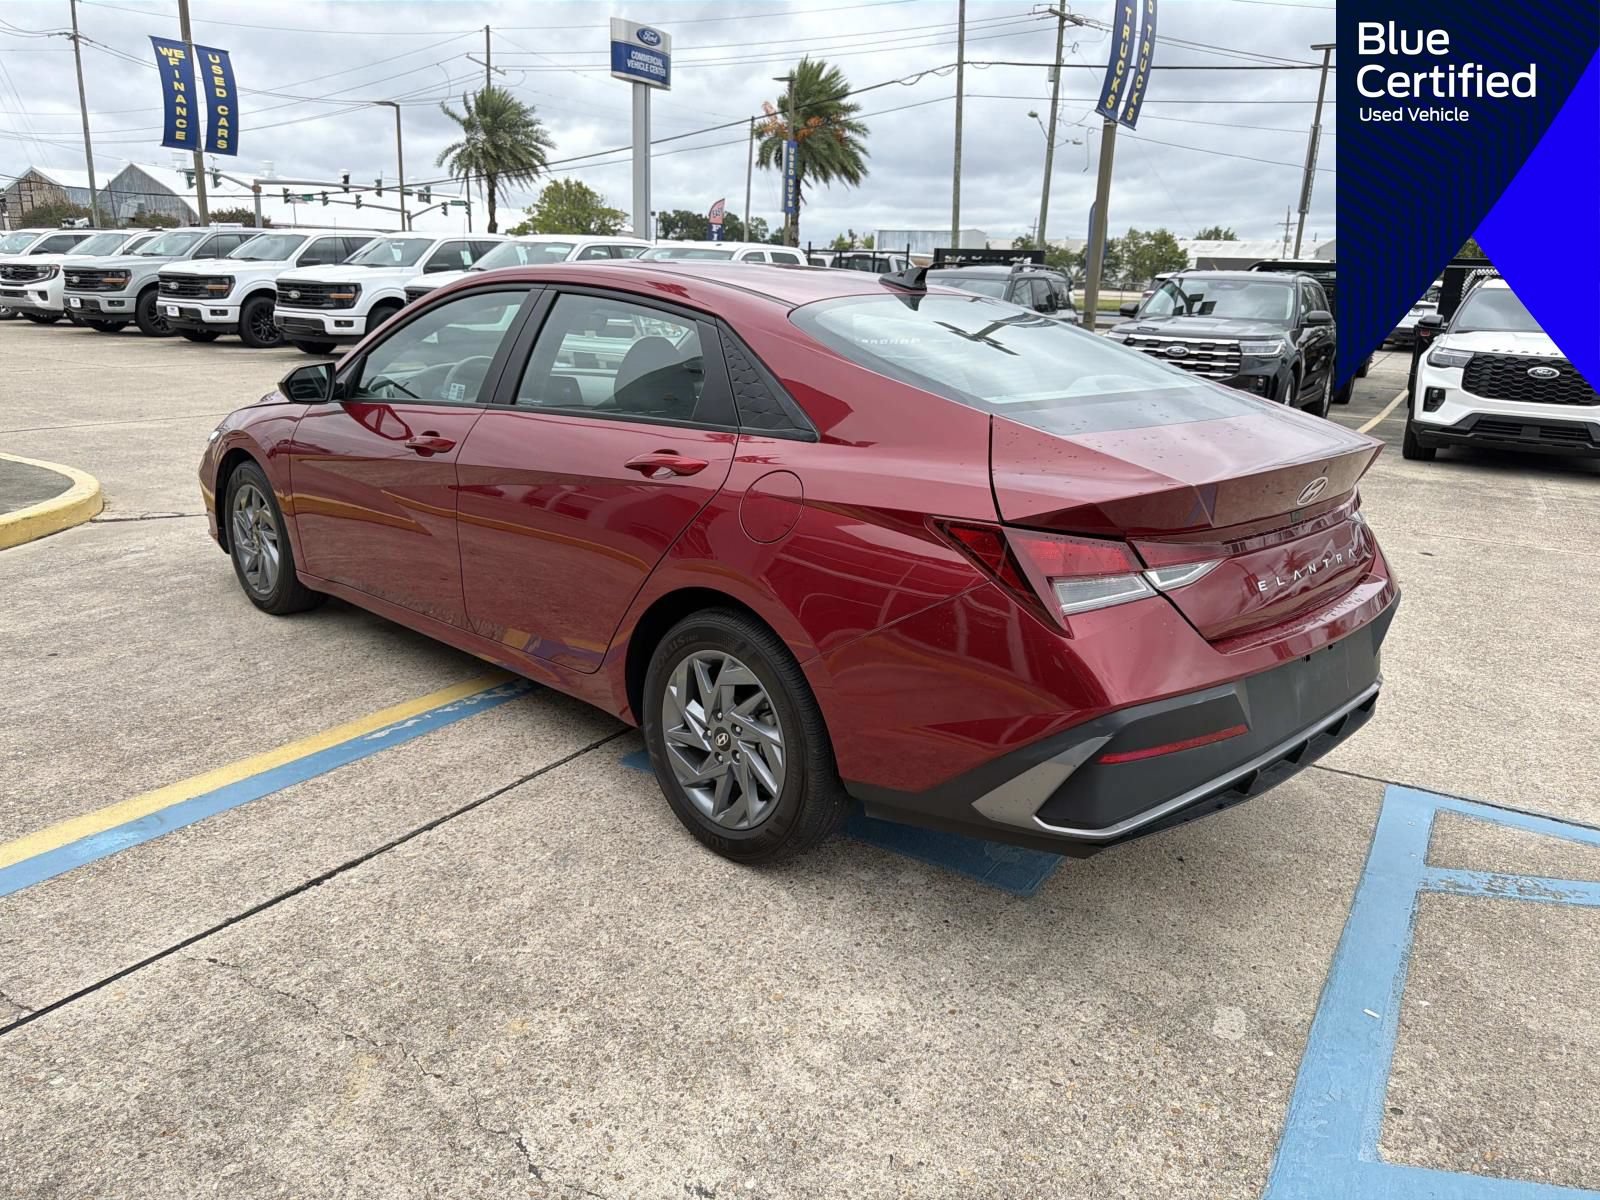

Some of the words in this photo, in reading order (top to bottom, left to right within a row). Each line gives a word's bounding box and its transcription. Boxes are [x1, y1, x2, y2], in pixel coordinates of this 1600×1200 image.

[158, 46, 185, 59] WE
[626, 58, 649, 72] VEHICLE
[649, 64, 666, 77] CENTER
[631, 50, 663, 67] COMMERCIAL
[1106, 6, 1132, 109] TRUCKS
[1126, 24, 1153, 120] TRUCKS
[208, 53, 227, 98] USED
[168, 57, 187, 140] FINANCE
[216, 105, 229, 149] CARS
[1257, 548, 1357, 592] ELANTRA
